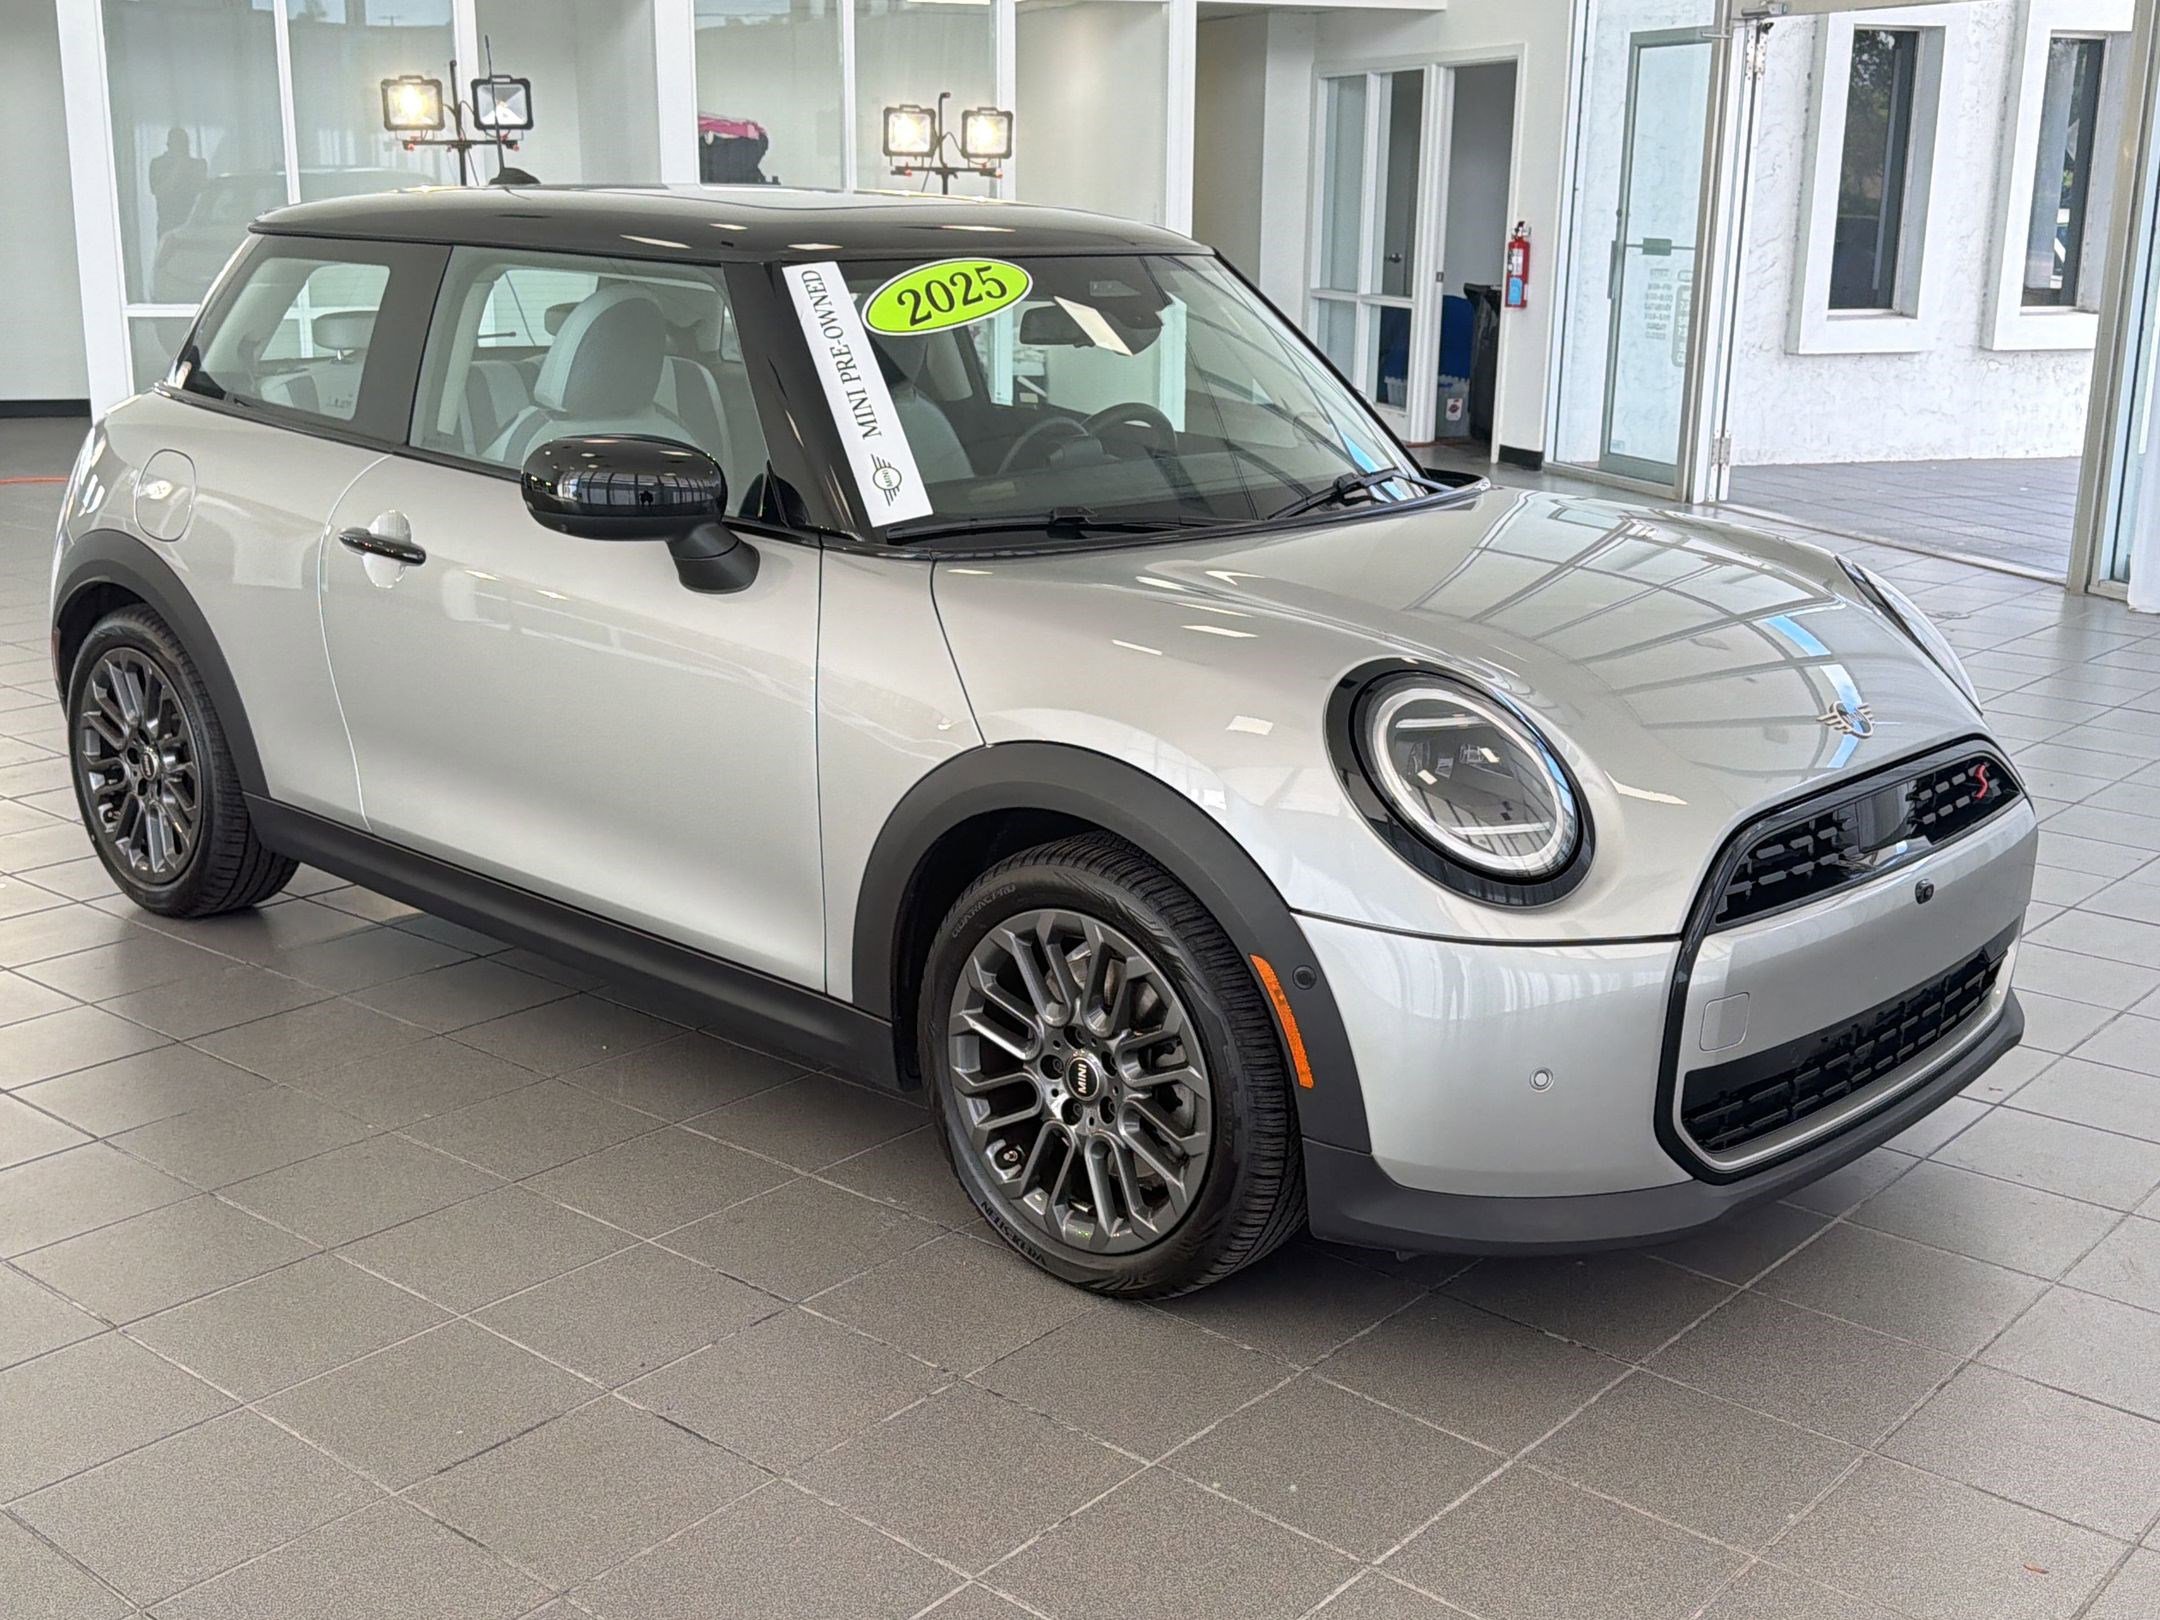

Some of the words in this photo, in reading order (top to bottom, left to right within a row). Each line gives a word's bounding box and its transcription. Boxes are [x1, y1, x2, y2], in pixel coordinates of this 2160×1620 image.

[897, 265, 1007, 327] 2025
[801, 270, 862, 385] PRE-OWNED
[846, 387, 882, 440] MINI
[1077, 1063, 1087, 1094] MINI
